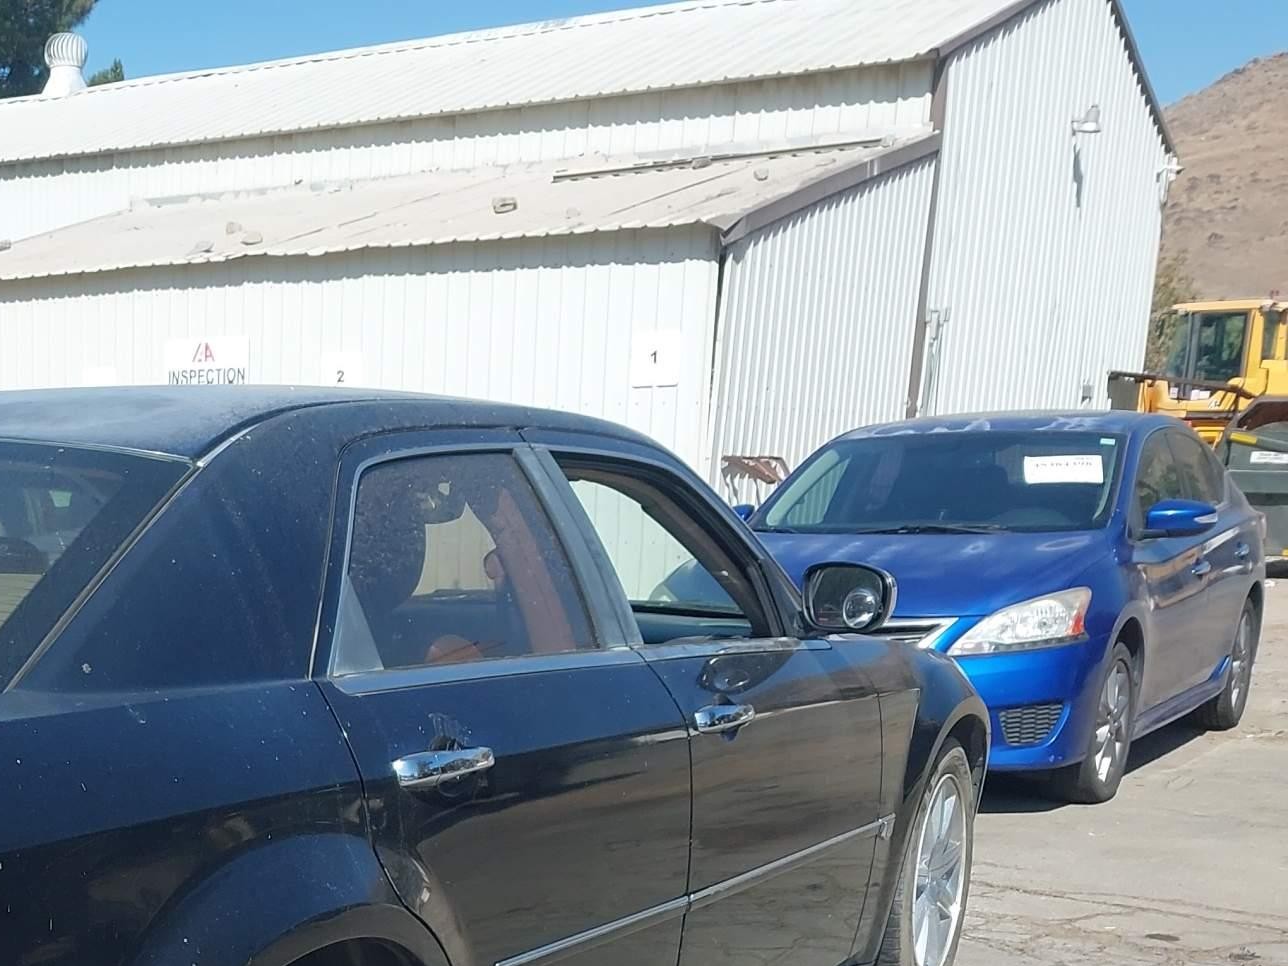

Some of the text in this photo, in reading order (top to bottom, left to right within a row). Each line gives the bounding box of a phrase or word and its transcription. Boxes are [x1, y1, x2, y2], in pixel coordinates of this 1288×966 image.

[650, 350, 658, 364] 1
[168, 367, 245, 384] INSPECTION
[336, 369, 345, 383] 2
